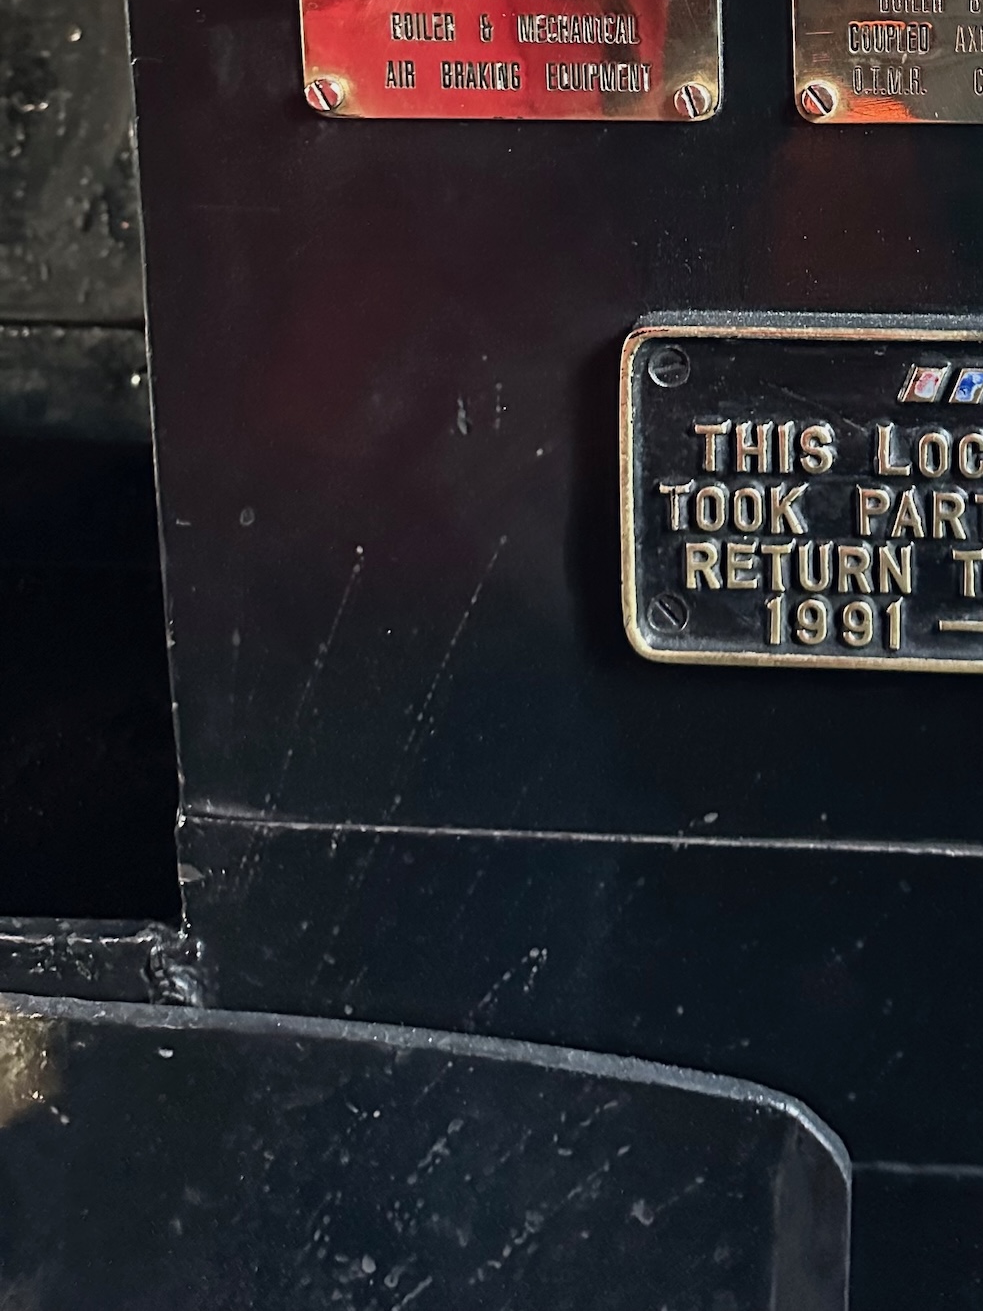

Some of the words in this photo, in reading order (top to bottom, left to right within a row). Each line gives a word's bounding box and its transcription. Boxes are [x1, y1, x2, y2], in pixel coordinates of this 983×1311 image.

[390, 12, 456, 41] BOILER
[480, 14, 493, 42] &
[517, 13, 640, 45] MECHANICAL
[848, 22, 931, 54] COUPLED
[385, 61, 416, 89] AIR
[440, 62, 521, 90] BRAKING
[545, 62, 652, 92] EQUIPMENT
[694, 419, 834, 475] THIS
[658, 482, 810, 535] TOOK
[684, 541, 914, 595] RETURN
[764, 595, 904, 651] 1991
